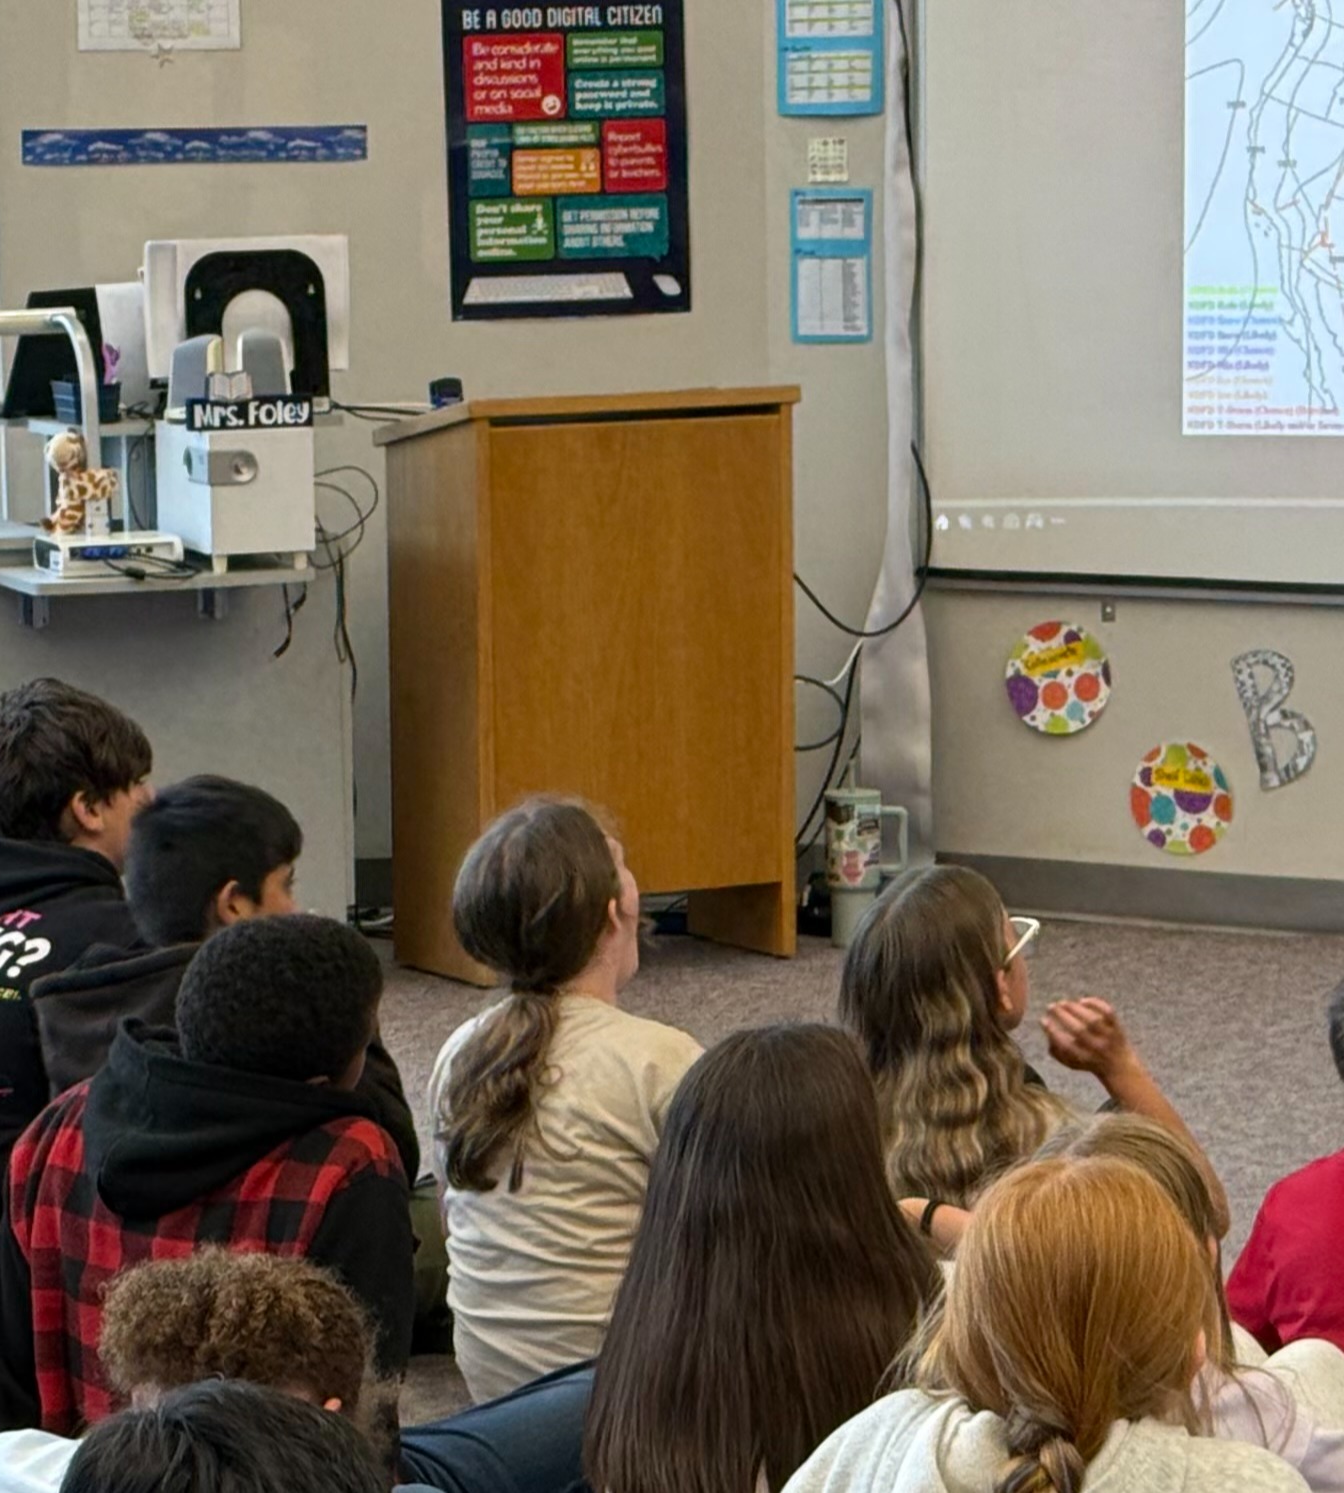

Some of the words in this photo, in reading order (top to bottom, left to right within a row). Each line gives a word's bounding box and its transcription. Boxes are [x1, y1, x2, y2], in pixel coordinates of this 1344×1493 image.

[462, 9, 481, 30] BE
[485, 10, 497, 29] A
[501, 8, 542, 29] GOOD
[547, 6, 602, 27] DIGITAL
[607, 5, 663, 26] CITIZEN
[472, 43, 488, 55] Be
[491, 42, 559, 55] considerate
[473, 58, 497, 71] and
[500, 57, 528, 70] kind
[529, 57, 541, 70] in
[473, 73, 539, 85] discussions
[574, 79, 610, 88] Create
[621, 78, 657, 89] strong
[473, 89, 488, 100] or
[490, 88, 507, 99] on
[510, 86, 542, 99] social
[574, 90, 628, 101] password
[630, 89, 651, 98] and
[473, 103, 513, 115] media
[574, 101, 603, 112] keep
[615, 100, 659, 111] private.
[608, 132, 642, 144] Report
[609, 156, 619, 167] to
[609, 170, 619, 179] or
[476, 204, 508, 214] Don't
[511, 204, 543, 214] share
[476, 217, 505, 227] your
[476, 225, 527, 237] personal
[476, 235, 548, 247] information
[193, 404, 245, 429] Mrs.
[248, 400, 310, 425] Foley
